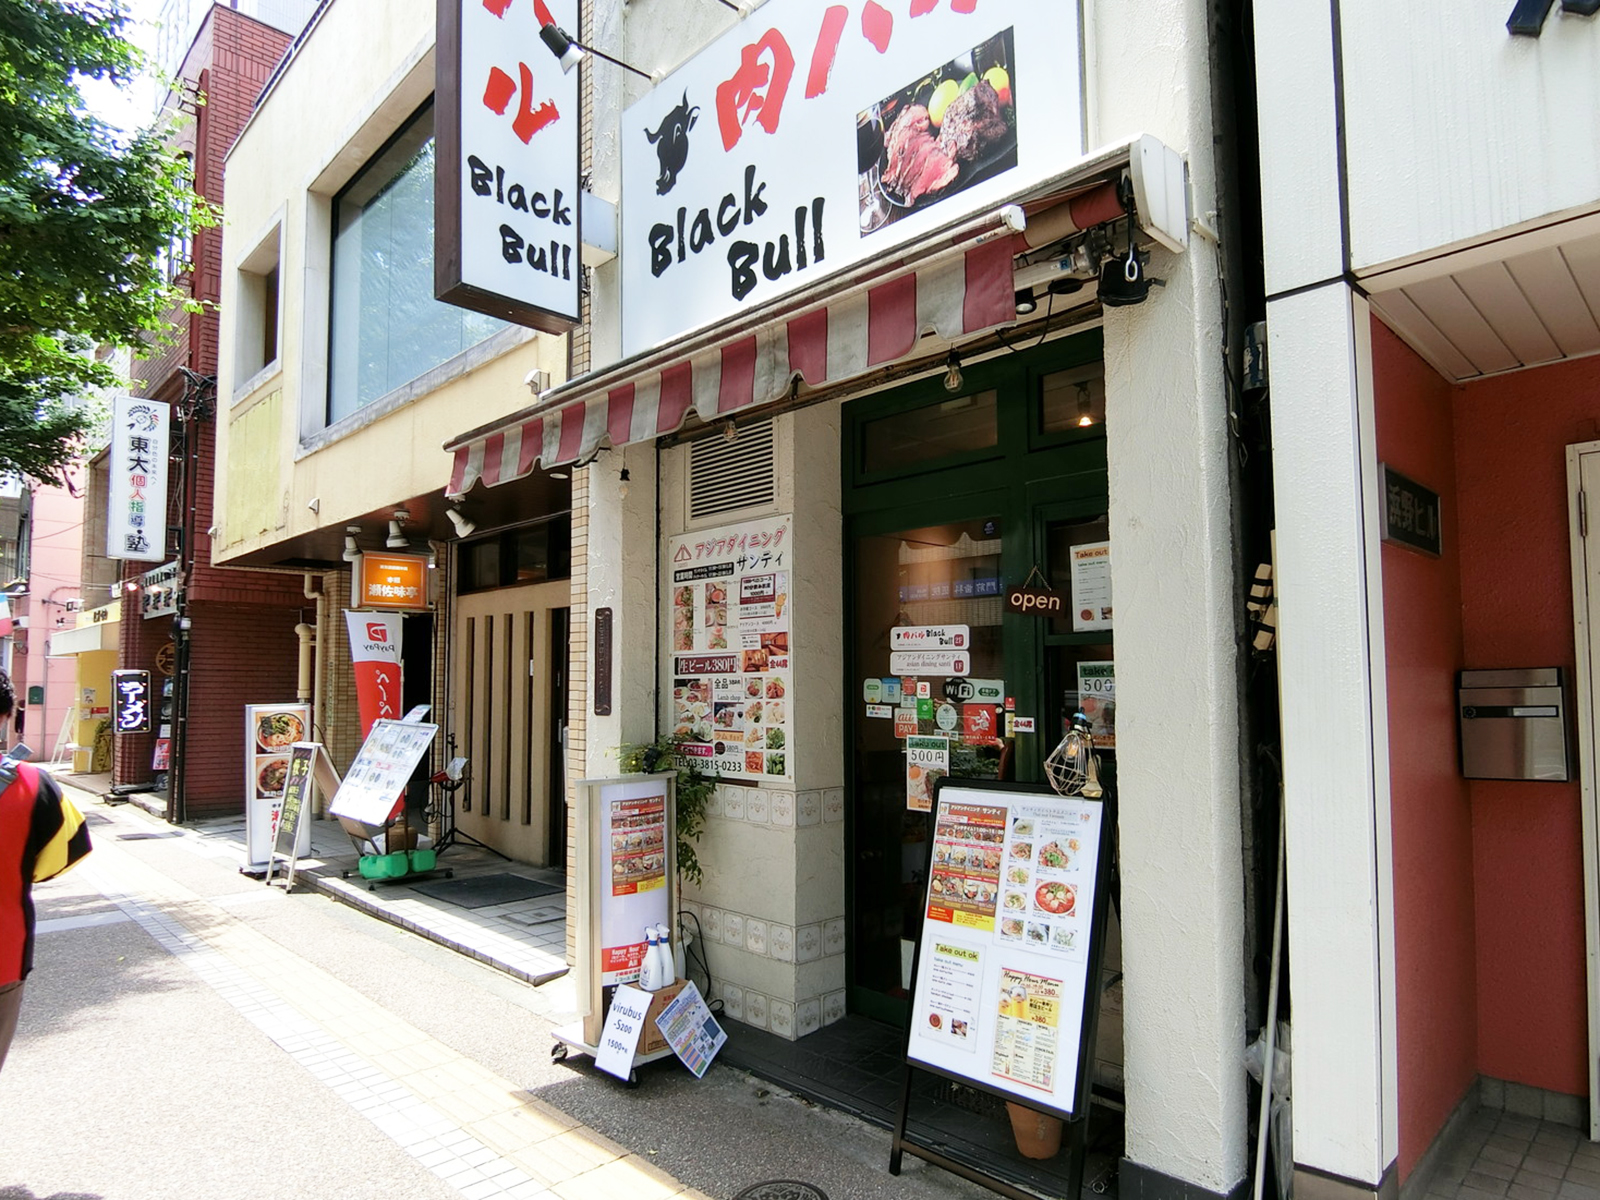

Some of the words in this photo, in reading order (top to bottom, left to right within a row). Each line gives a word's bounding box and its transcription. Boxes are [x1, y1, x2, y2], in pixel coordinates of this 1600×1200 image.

[468, 154, 571, 226] Black
[648, 165, 768, 278] Black
[499, 223, 571, 281] Bull
[727, 197, 825, 301] Bull
[127, 436, 149, 553] 東大個人指導塾
[1074, 550, 1094, 559] Take
[1094, 548, 1108, 556] out
[1010, 592, 1061, 611] open
[926, 629, 946, 638] Black
[939, 637, 954, 646] Bull
[955, 635, 964, 645] 2F
[680, 659, 737, 673] 生ビール380円
[121, 681, 145, 728] ラーメン
[900, 725, 913, 733] PAY
[911, 750, 945, 763] 500円
[611, 947, 627, 956] Happy
[935, 943, 953, 954] Take
[954, 949, 967, 958] out
[968, 951, 978, 959] ok
[613, 1002, 642, 1021] virubus
